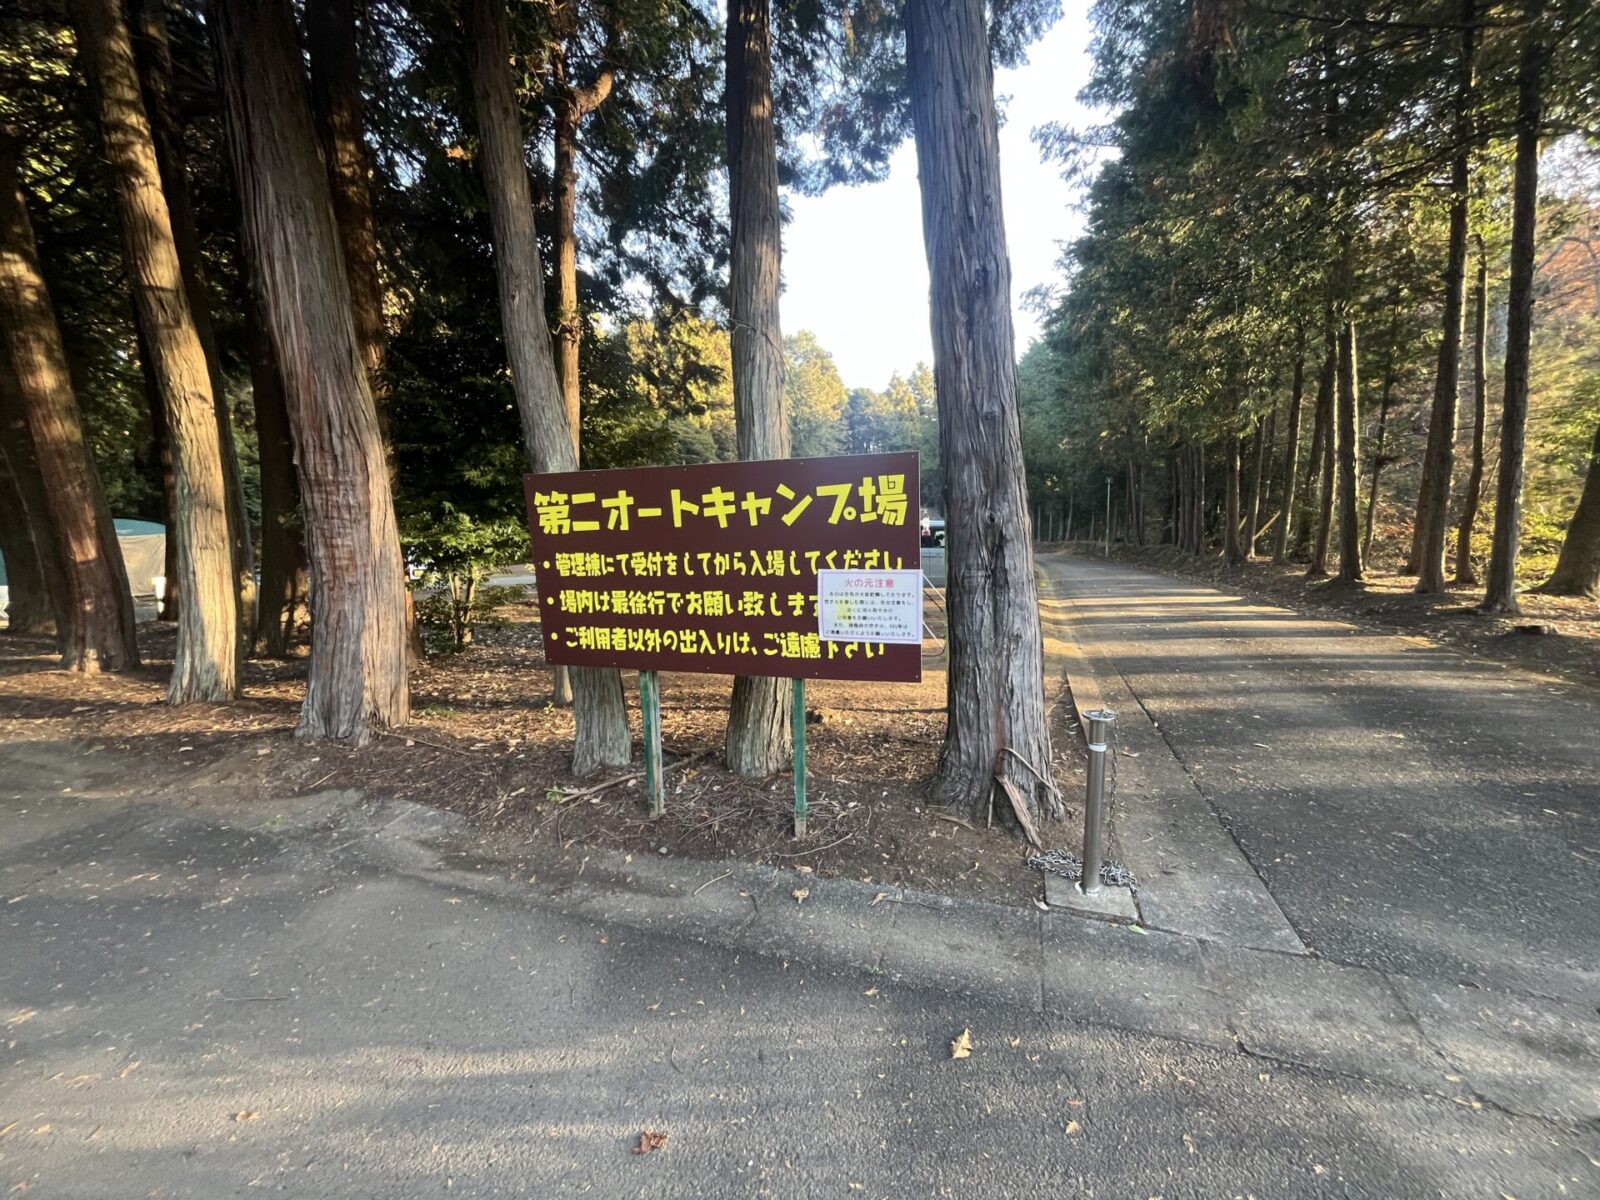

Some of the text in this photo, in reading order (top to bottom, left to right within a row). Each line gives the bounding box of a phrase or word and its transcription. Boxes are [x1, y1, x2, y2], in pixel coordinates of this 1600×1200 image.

[534, 474, 908, 535] 第二オートキャンプ場
[844, 578, 894, 588] 火の元注意
